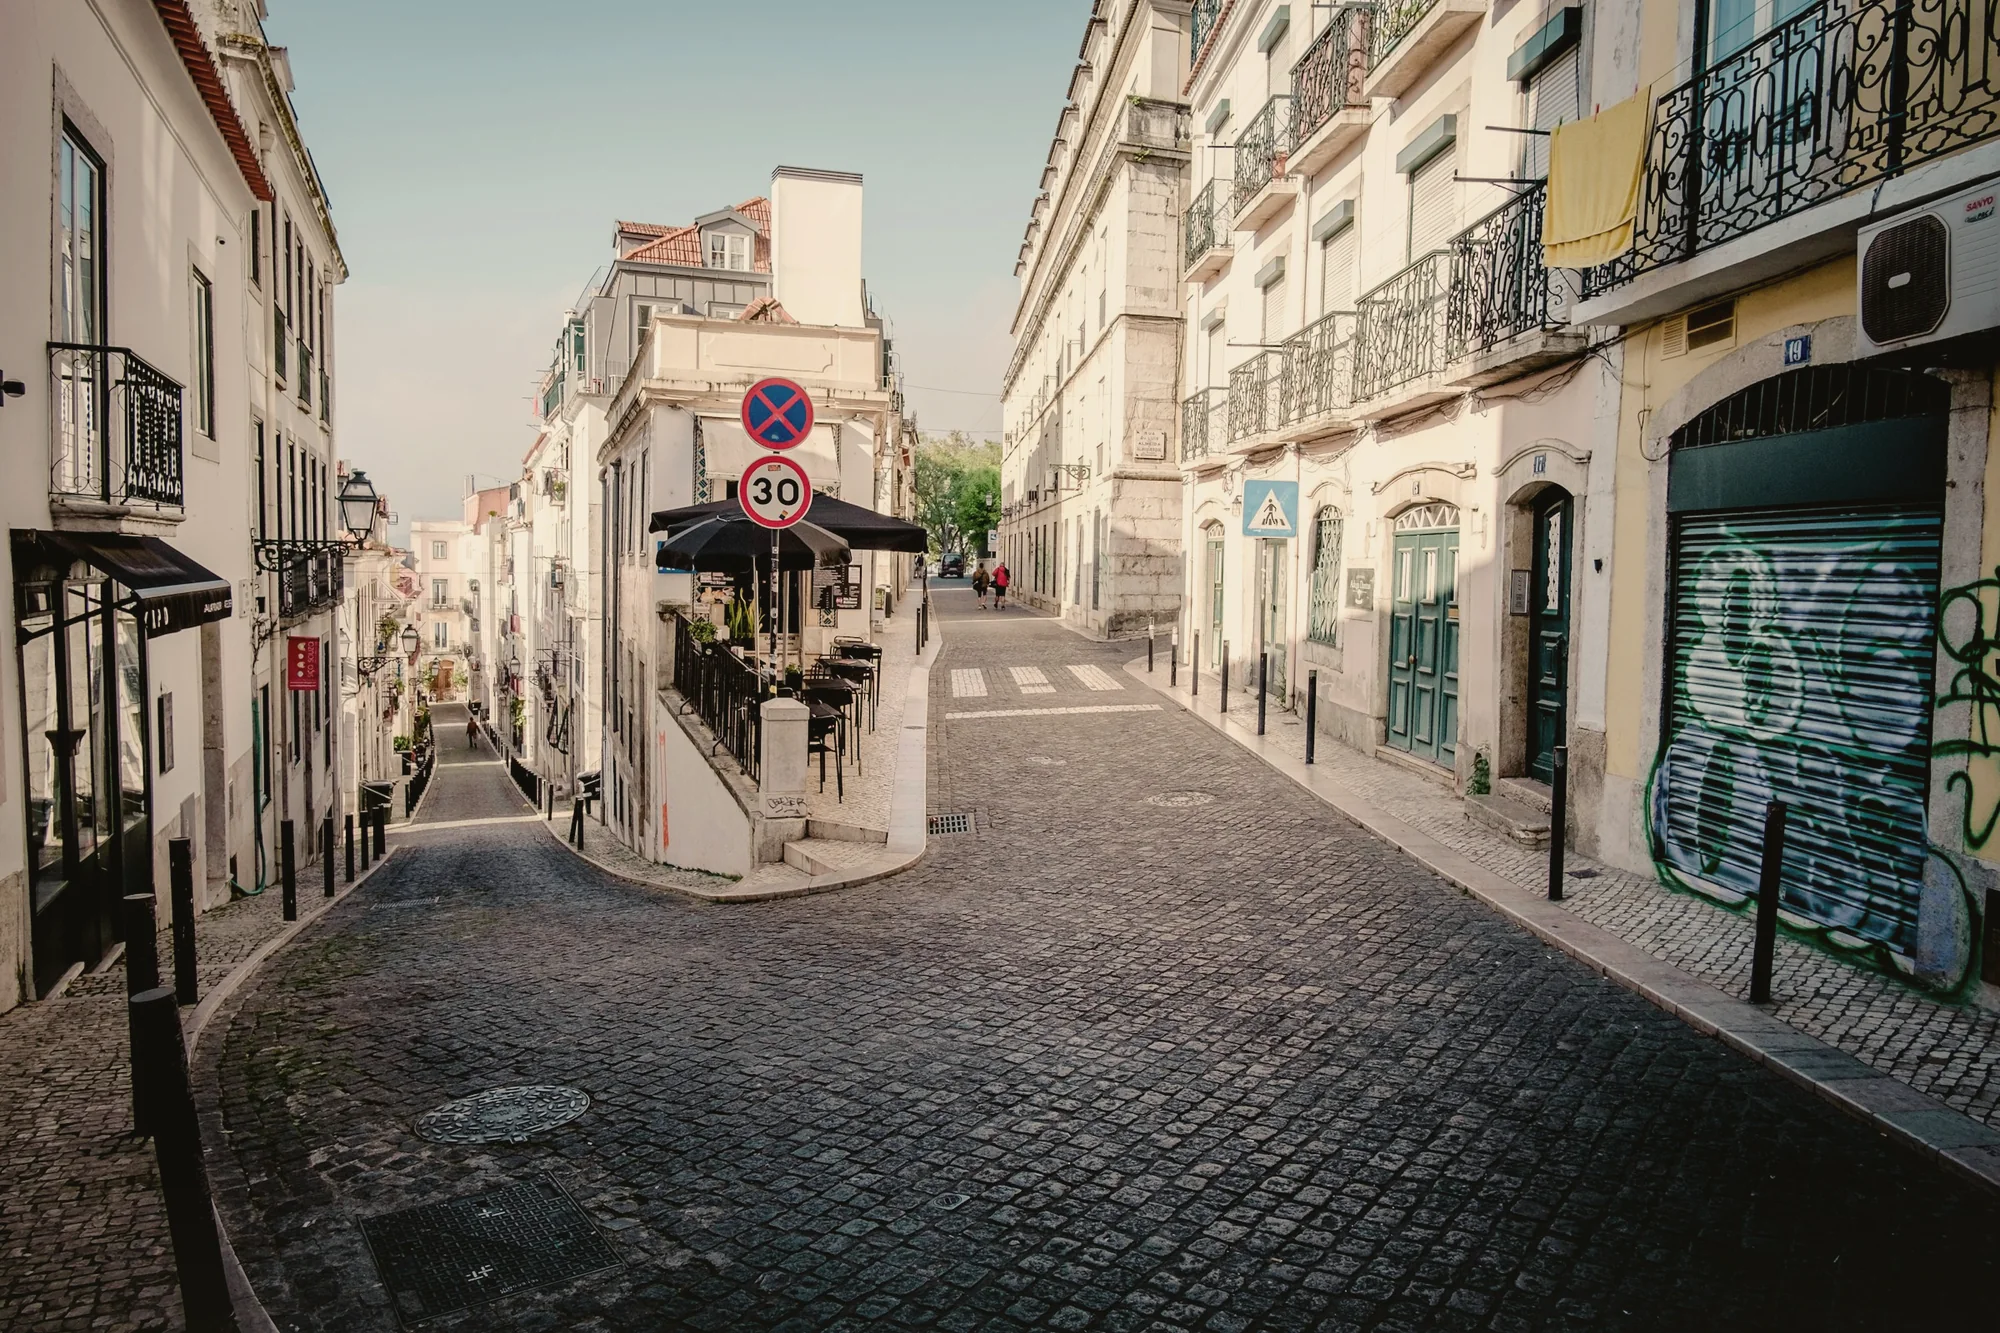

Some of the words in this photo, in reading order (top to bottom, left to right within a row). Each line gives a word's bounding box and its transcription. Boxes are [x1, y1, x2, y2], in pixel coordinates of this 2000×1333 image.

[1966, 196, 1994, 212] SANYO
[1789, 339, 1802, 363] 19
[752, 477, 799, 506] 30
